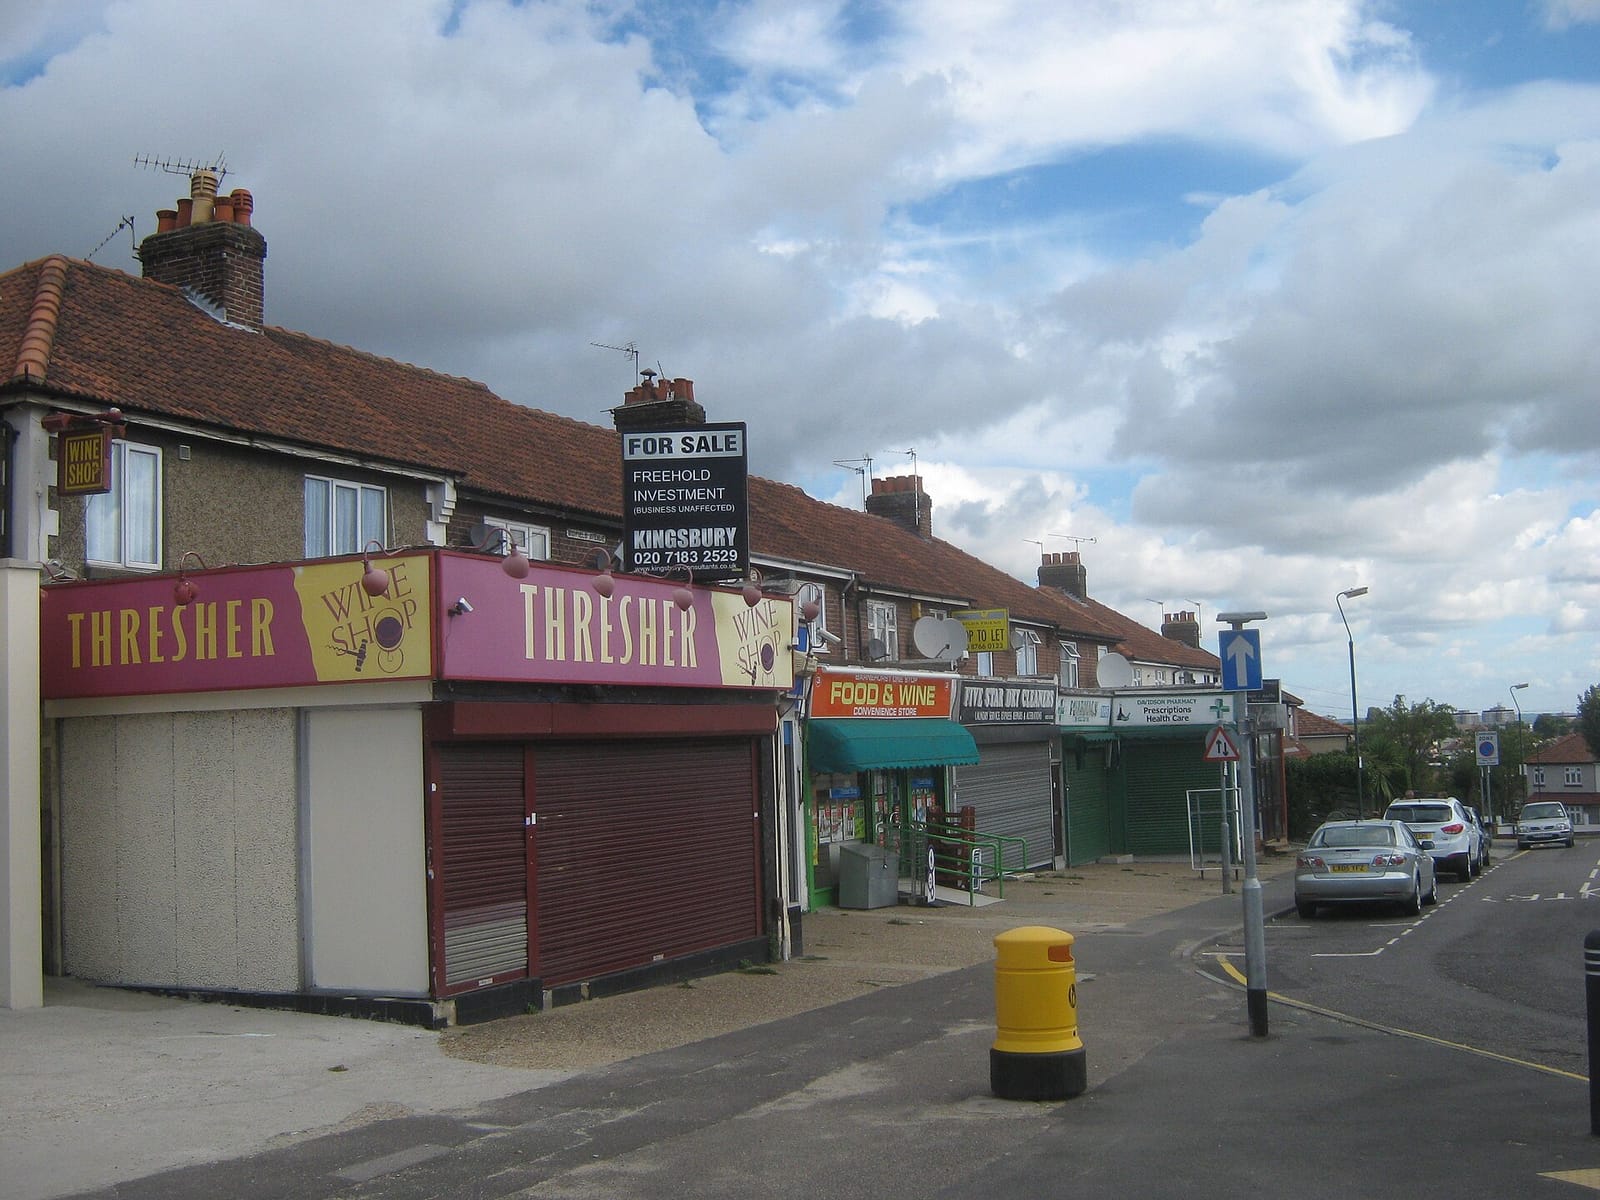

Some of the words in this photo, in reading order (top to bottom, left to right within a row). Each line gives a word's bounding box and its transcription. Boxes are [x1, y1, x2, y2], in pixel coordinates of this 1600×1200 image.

[68, 439, 99, 461] WINE
[628, 437, 674, 455] FOR
[681, 434, 738, 454] SALE
[68, 461, 100, 485] SHOP
[633, 469, 711, 483] FREEHOLD
[634, 487, 725, 502] INVESTMENT
[633, 506, 677, 515] (BUSINESS
[678, 504, 735, 513] UNAFFECTED)
[634, 527, 737, 550] KINGSBURY
[634, 552, 661, 565] 020
[665, 551, 698, 564] 7183
[703, 549, 738, 563] 2529
[331, 599, 417, 656] SHOP
[519, 584, 698, 669] THRESHER
[732, 600, 779, 643] WINE
[67, 598, 275, 668] THRESHER
[977, 629, 987, 642] TO
[991, 629, 1005, 641] LET
[737, 630, 781, 675] SHOP
[831, 681, 879, 705] FOOD
[883, 683, 894, 705] &
[899, 685, 936, 706] WINE
[984, 687, 1004, 707] STAR
[853, 707, 897, 716] CONVENIENCE
[897, 707, 917, 716] STORE
[1144, 706, 1192, 715] Prescriptions
